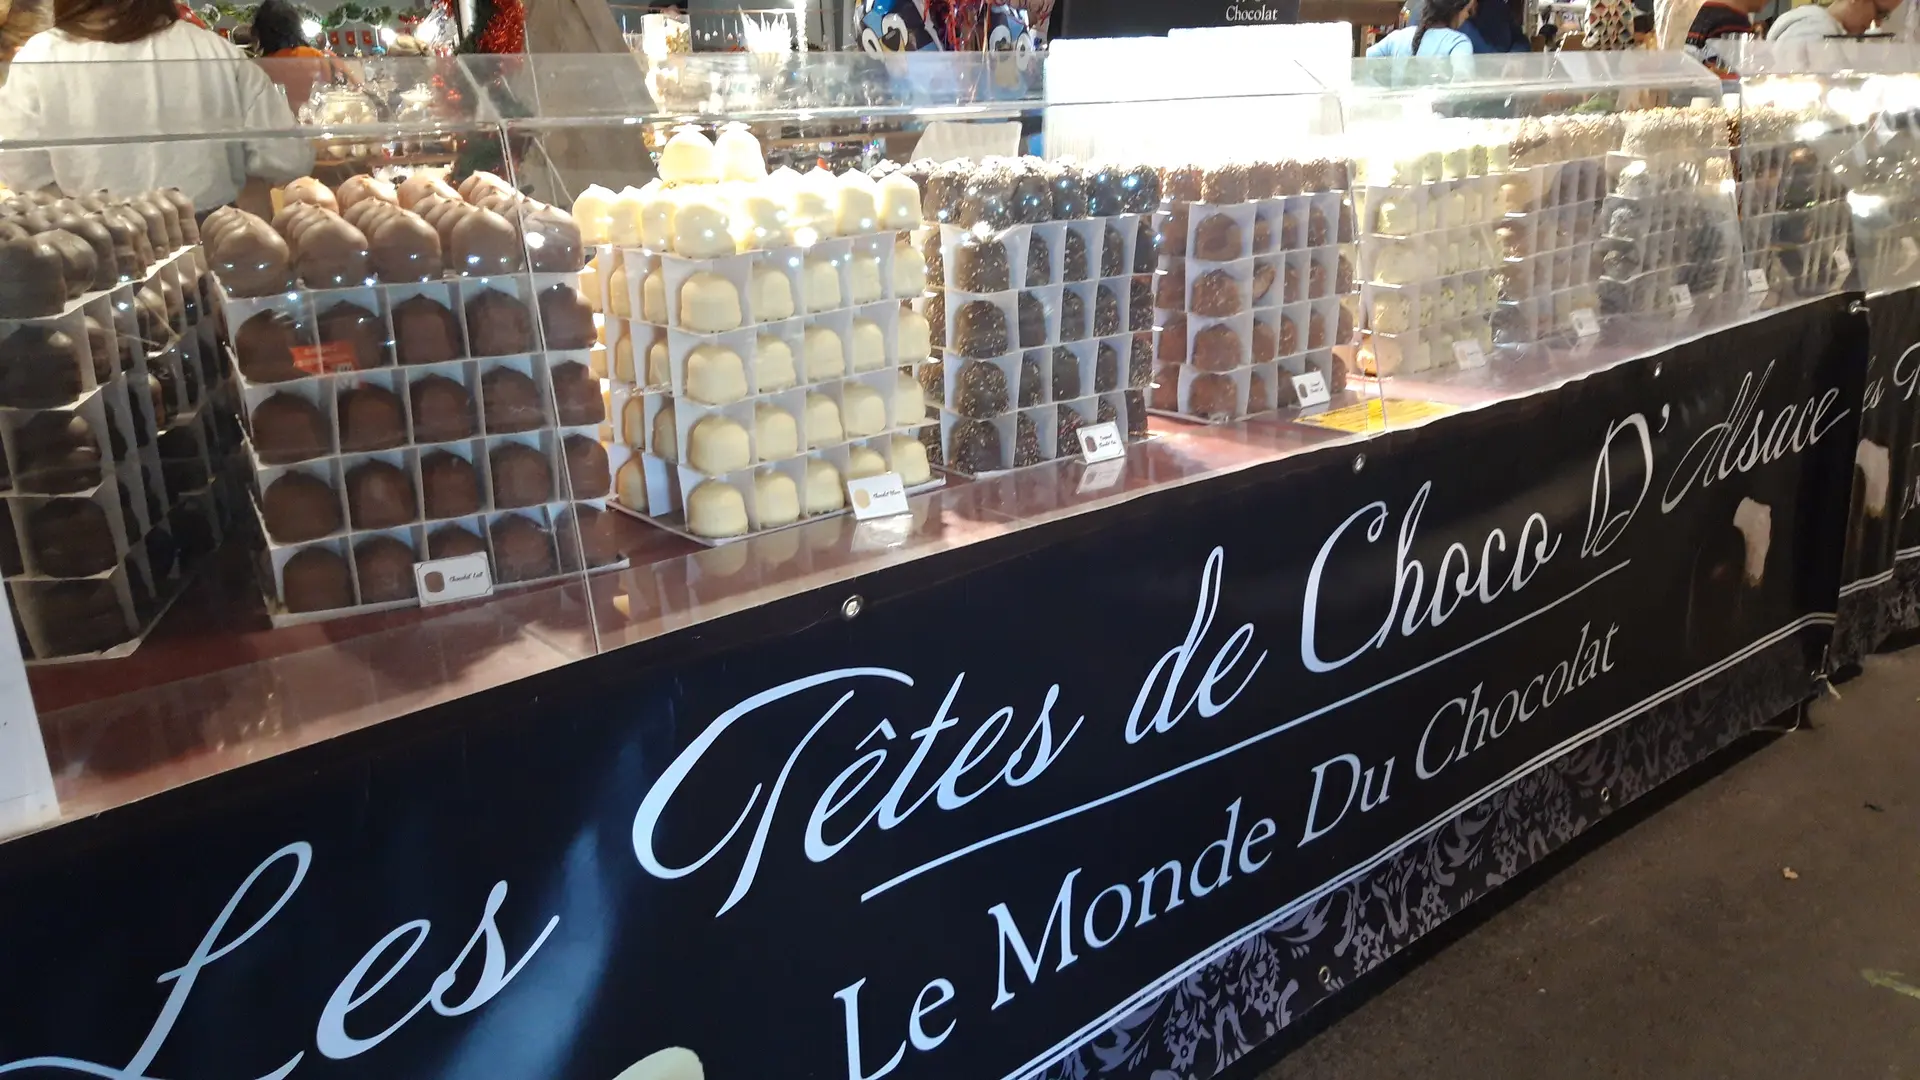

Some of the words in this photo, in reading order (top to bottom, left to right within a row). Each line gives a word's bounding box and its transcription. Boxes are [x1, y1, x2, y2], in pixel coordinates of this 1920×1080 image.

[1225, 4, 1279, 21] Chocolat
[0, 841, 560, 1080] Les
[632, 667, 1084, 918] Têtes
[1124, 546, 1267, 745] de
[1300, 480, 1562, 673] Choco
[833, 977, 957, 1080] Le
[988, 797, 1276, 1011] Monde
[1297, 753, 1395, 848] Du
[1415, 620, 1620, 780] Chocolat
